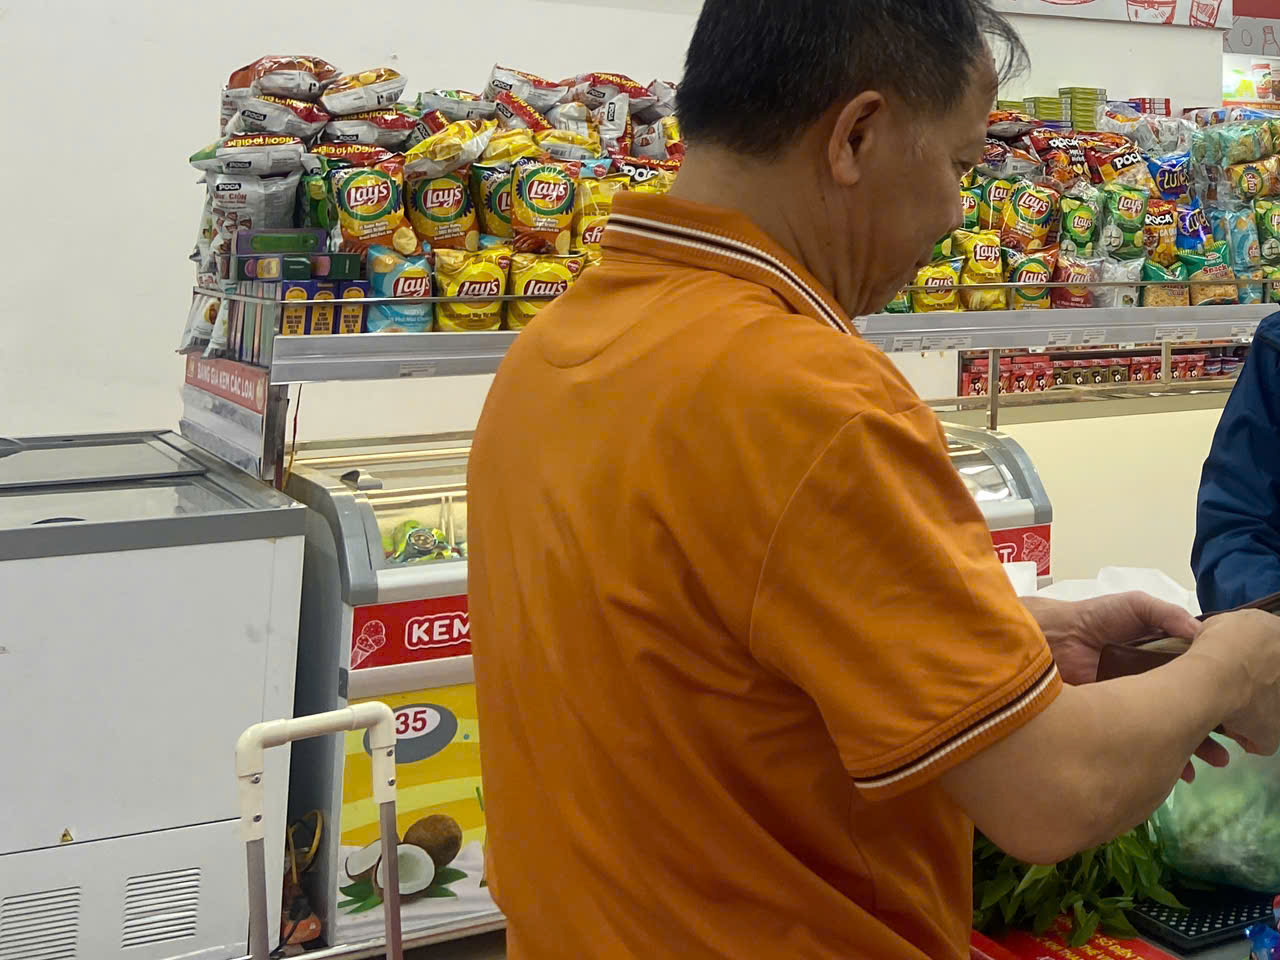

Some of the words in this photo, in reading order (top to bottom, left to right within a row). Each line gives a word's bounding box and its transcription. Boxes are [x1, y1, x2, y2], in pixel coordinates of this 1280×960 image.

[217, 183, 241, 191] POCA
[349, 182, 389, 206] Lay's
[425, 186, 463, 209] Lay's
[529, 179, 568, 202] Lay's
[1017, 191, 1050, 213] Lay's
